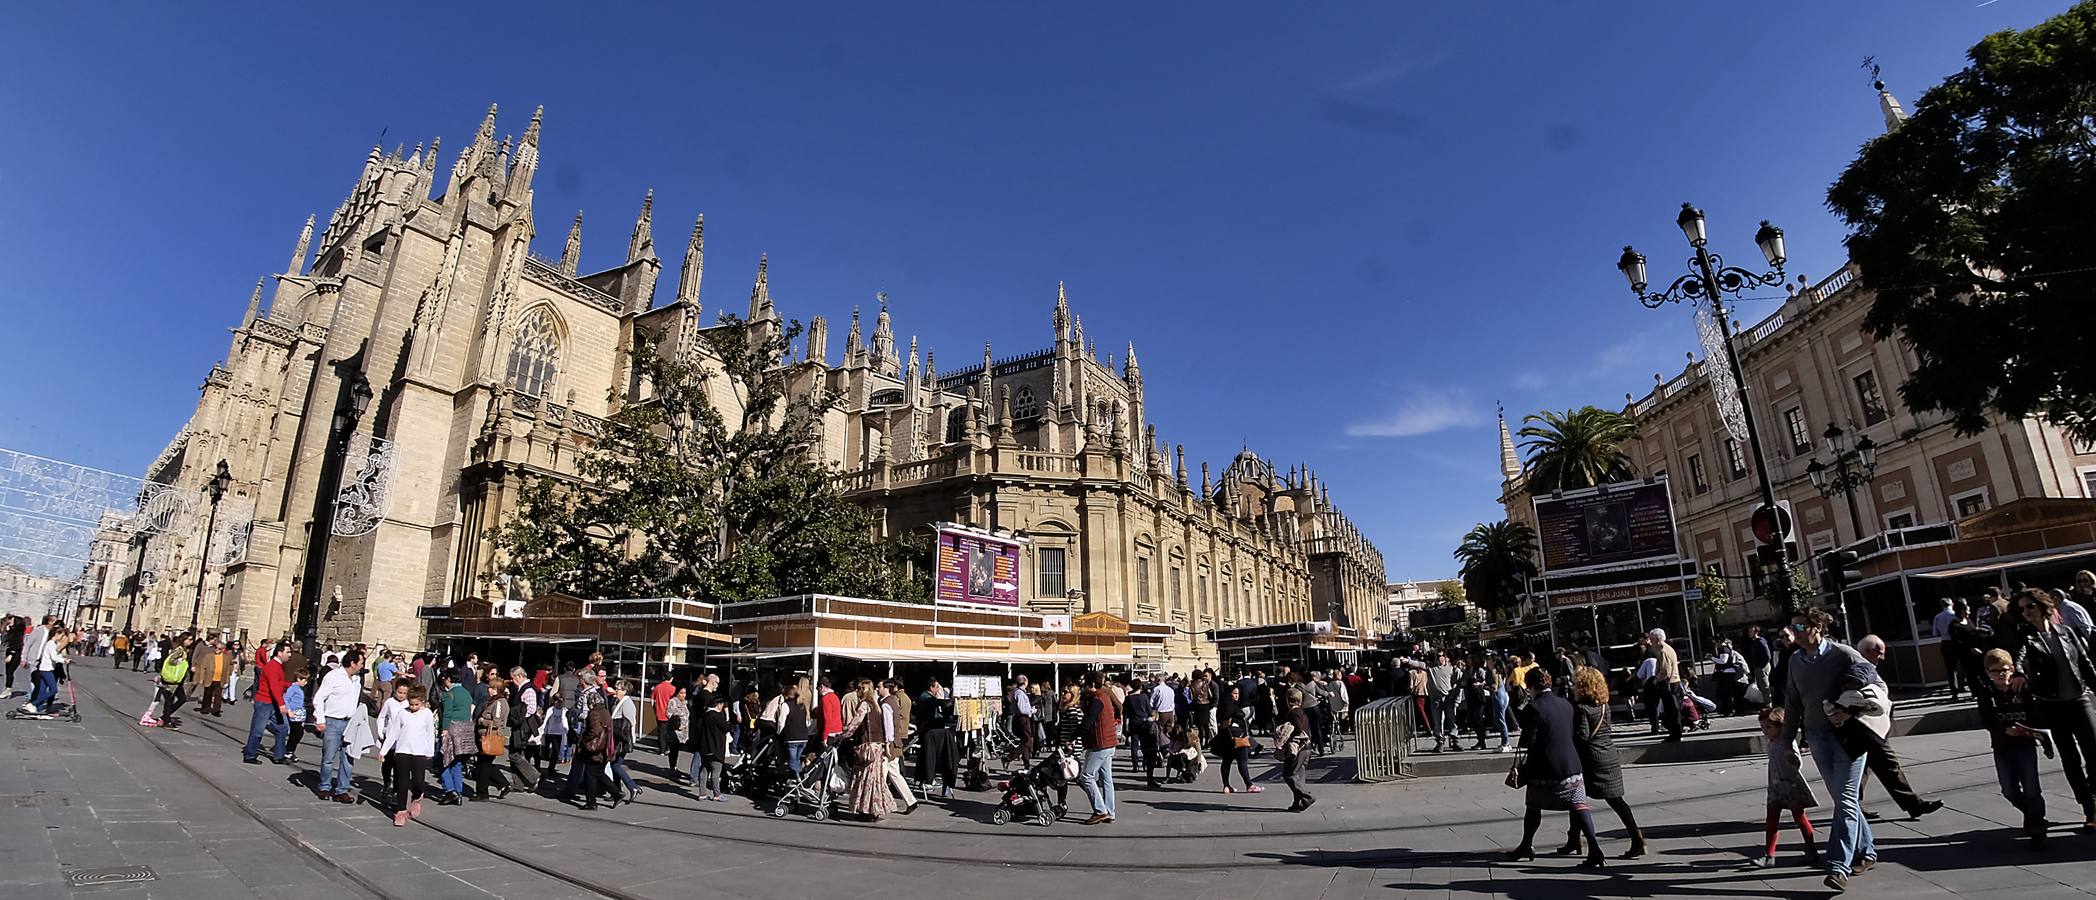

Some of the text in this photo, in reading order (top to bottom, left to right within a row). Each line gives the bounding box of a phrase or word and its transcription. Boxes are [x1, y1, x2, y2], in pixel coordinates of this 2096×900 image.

[1557, 584, 1669, 604] BELENES SAN JUAN BOSCO
